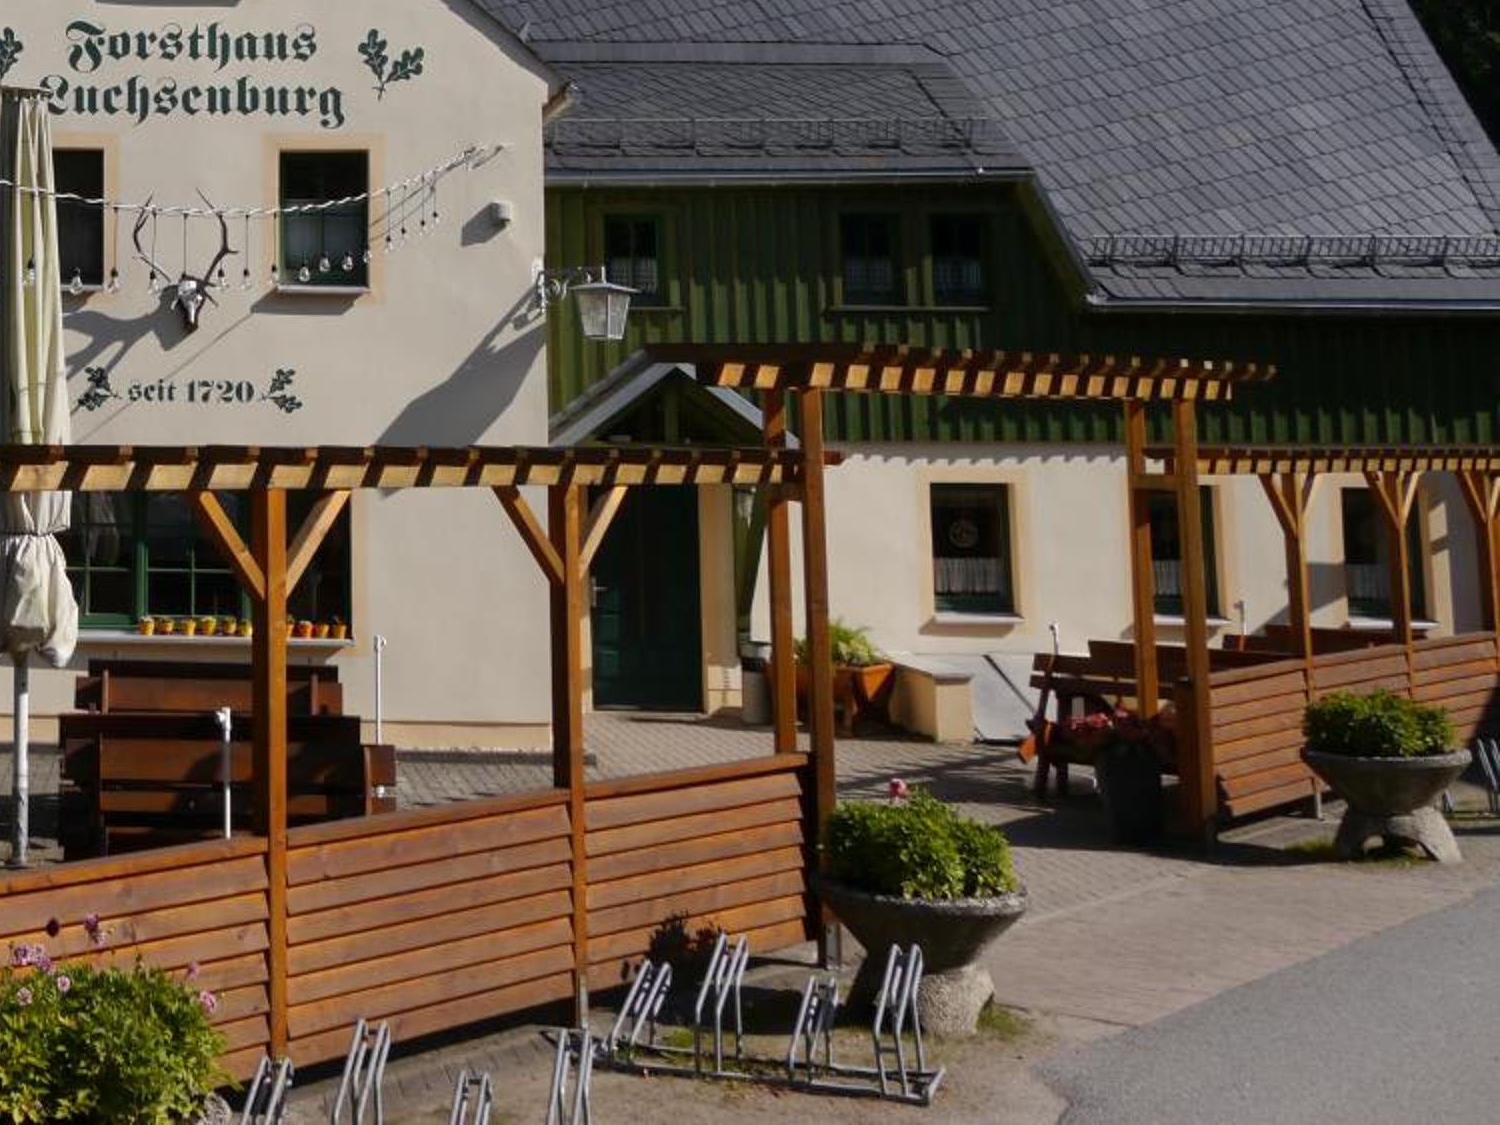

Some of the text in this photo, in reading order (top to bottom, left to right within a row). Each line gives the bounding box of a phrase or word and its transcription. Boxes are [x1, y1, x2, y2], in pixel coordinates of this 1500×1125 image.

[65, 20, 317, 74] Forsthaus
[40, 74, 346, 130] Luchsenburg
[127, 378, 255, 403] seit 1720
